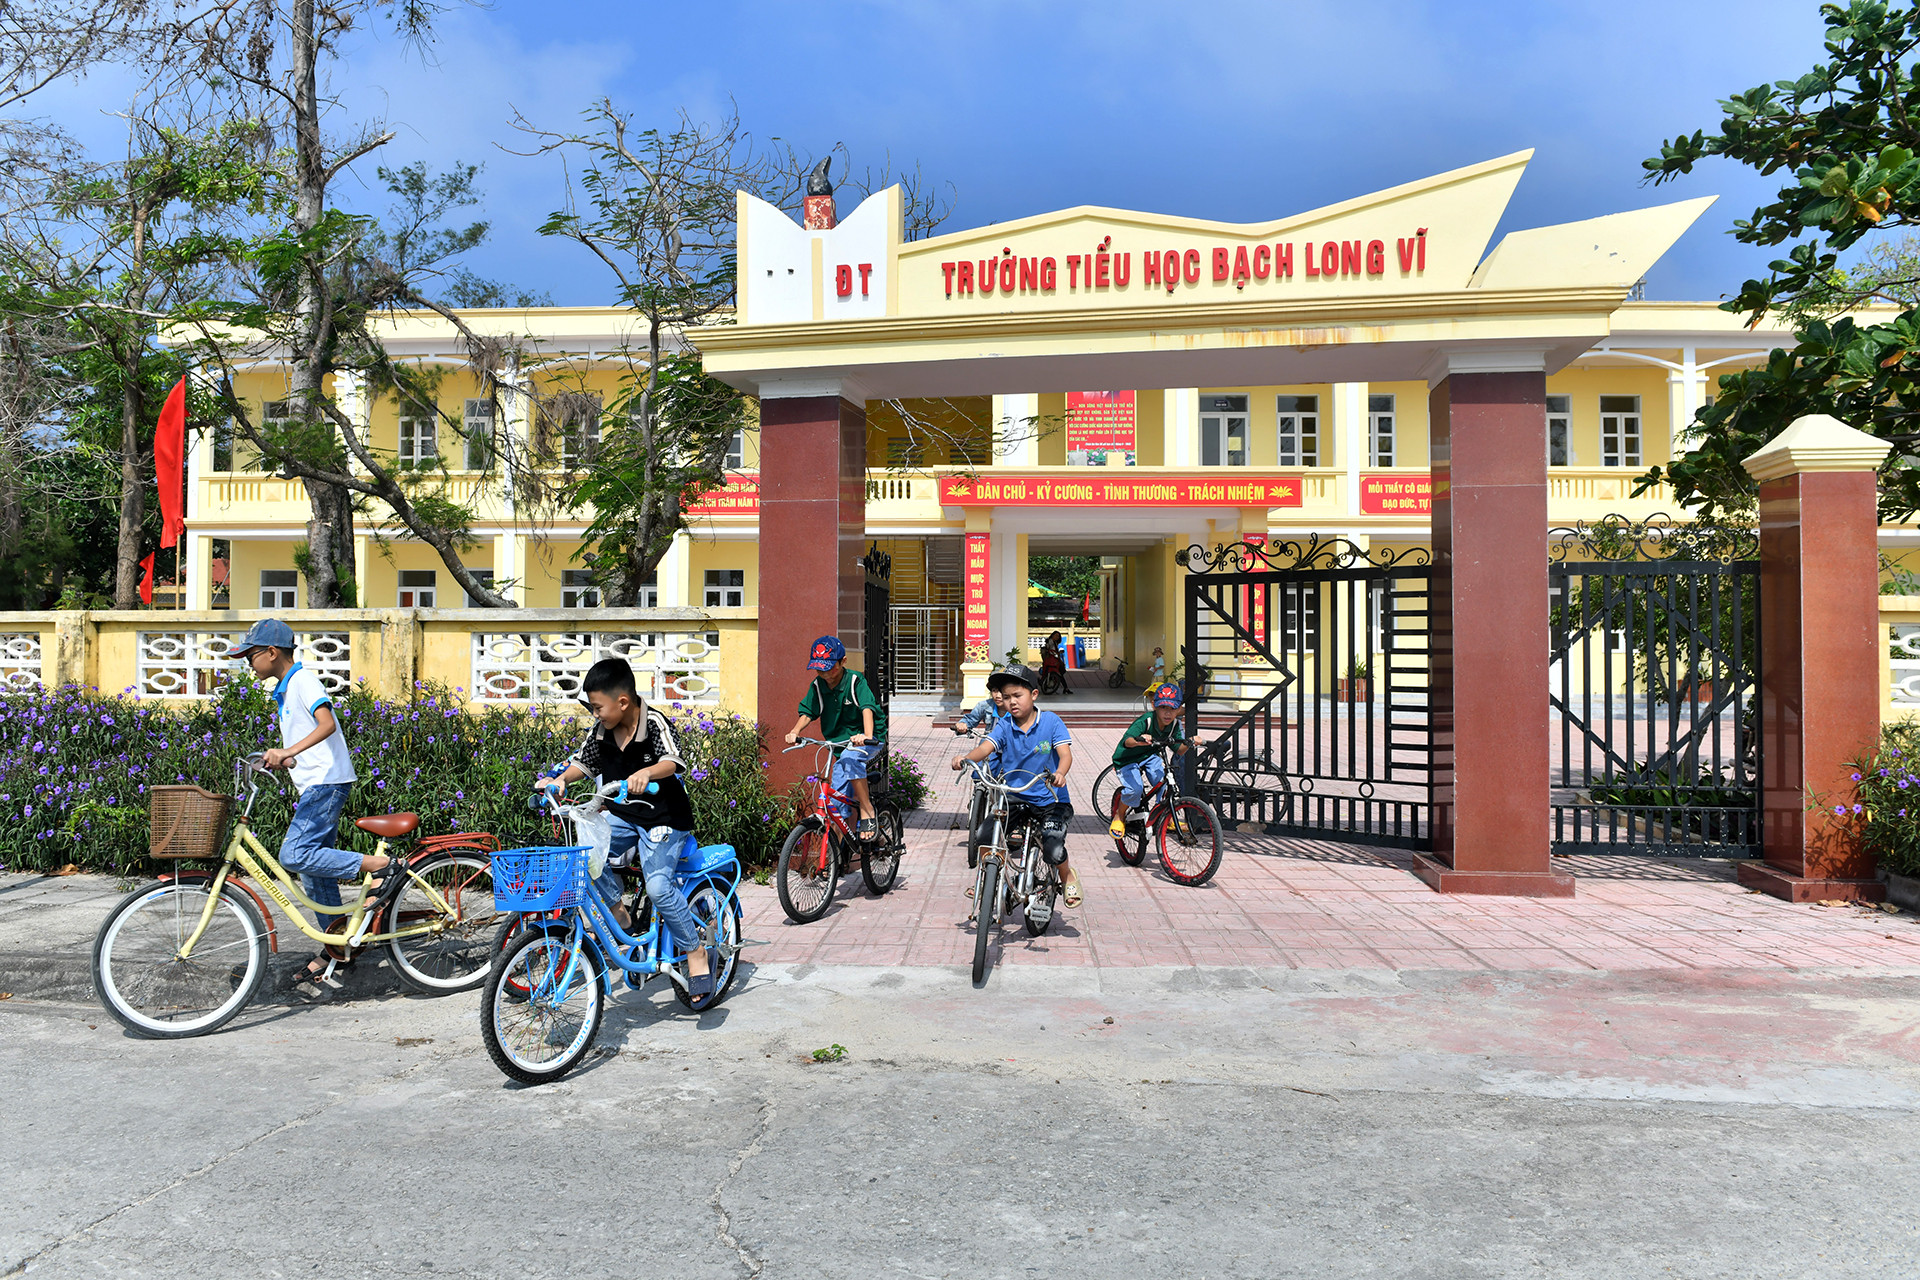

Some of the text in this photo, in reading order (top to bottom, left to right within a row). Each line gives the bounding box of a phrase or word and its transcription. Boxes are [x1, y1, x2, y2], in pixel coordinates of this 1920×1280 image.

[941, 228, 1429, 294] TRƯỜNG TIỂU HỌC BẠCH LONG VĨ
[976, 481, 1001, 500] DÂN
[1003, 480, 1027, 500] CHỦ
[1036, 480, 1052, 500] KỶ
[1054, 483, 1094, 501] CƯƠNG
[1103, 482, 1130, 501] TÌNH
[1132, 484, 1178, 501] THƯƠNG
[1187, 482, 1225, 501] TRÁCH
[1227, 482, 1265, 504] NHIỆM
[253, 868, 291, 908] KASAWA
